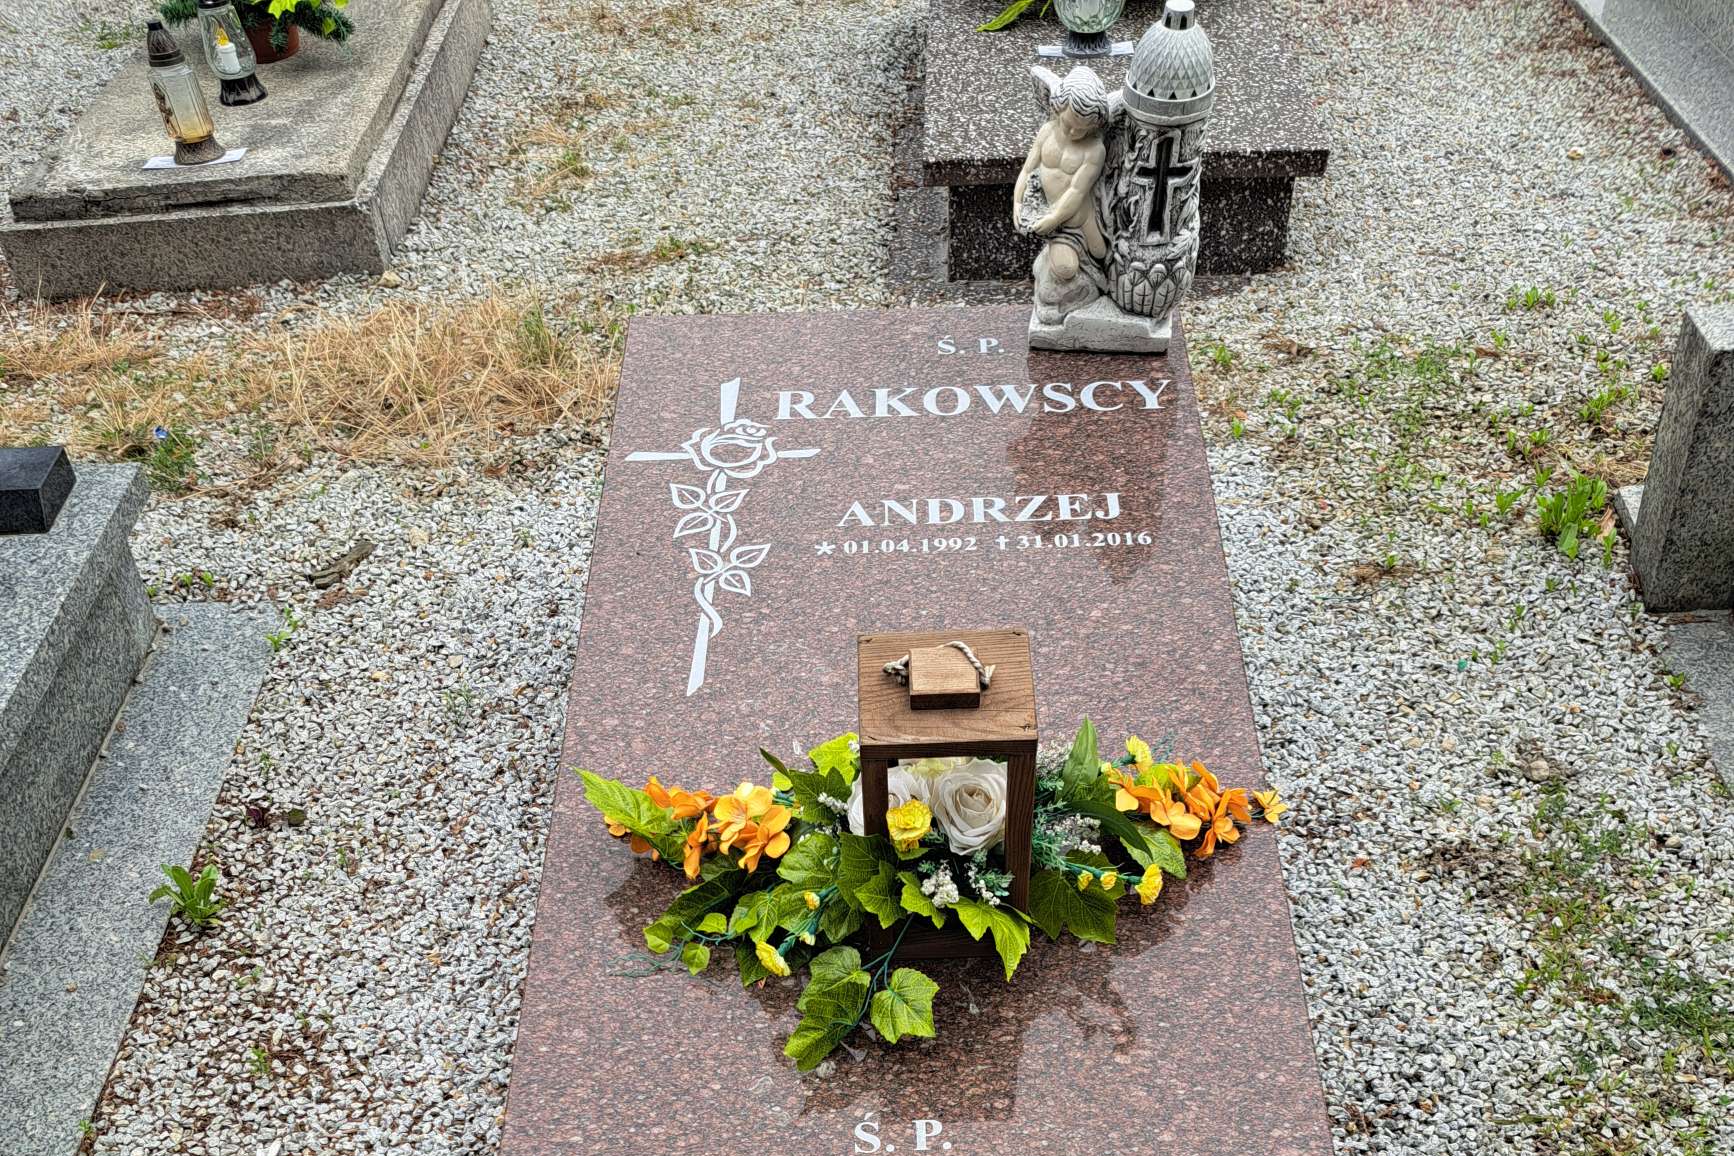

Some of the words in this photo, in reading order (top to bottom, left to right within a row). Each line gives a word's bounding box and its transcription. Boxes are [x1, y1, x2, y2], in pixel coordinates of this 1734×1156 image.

[937, 333, 966, 355] Ś.
[977, 337, 1005, 354] P.
[774, 379, 1172, 420] RAKOWSCY
[836, 492, 1122, 527] ANDRZEJ
[843, 536, 978, 555] 01.04.1992
[1015, 531, 1153, 550] 31.01.2016
[853, 1112, 896, 1154] Ś.
[912, 1118, 953, 1151] P.
